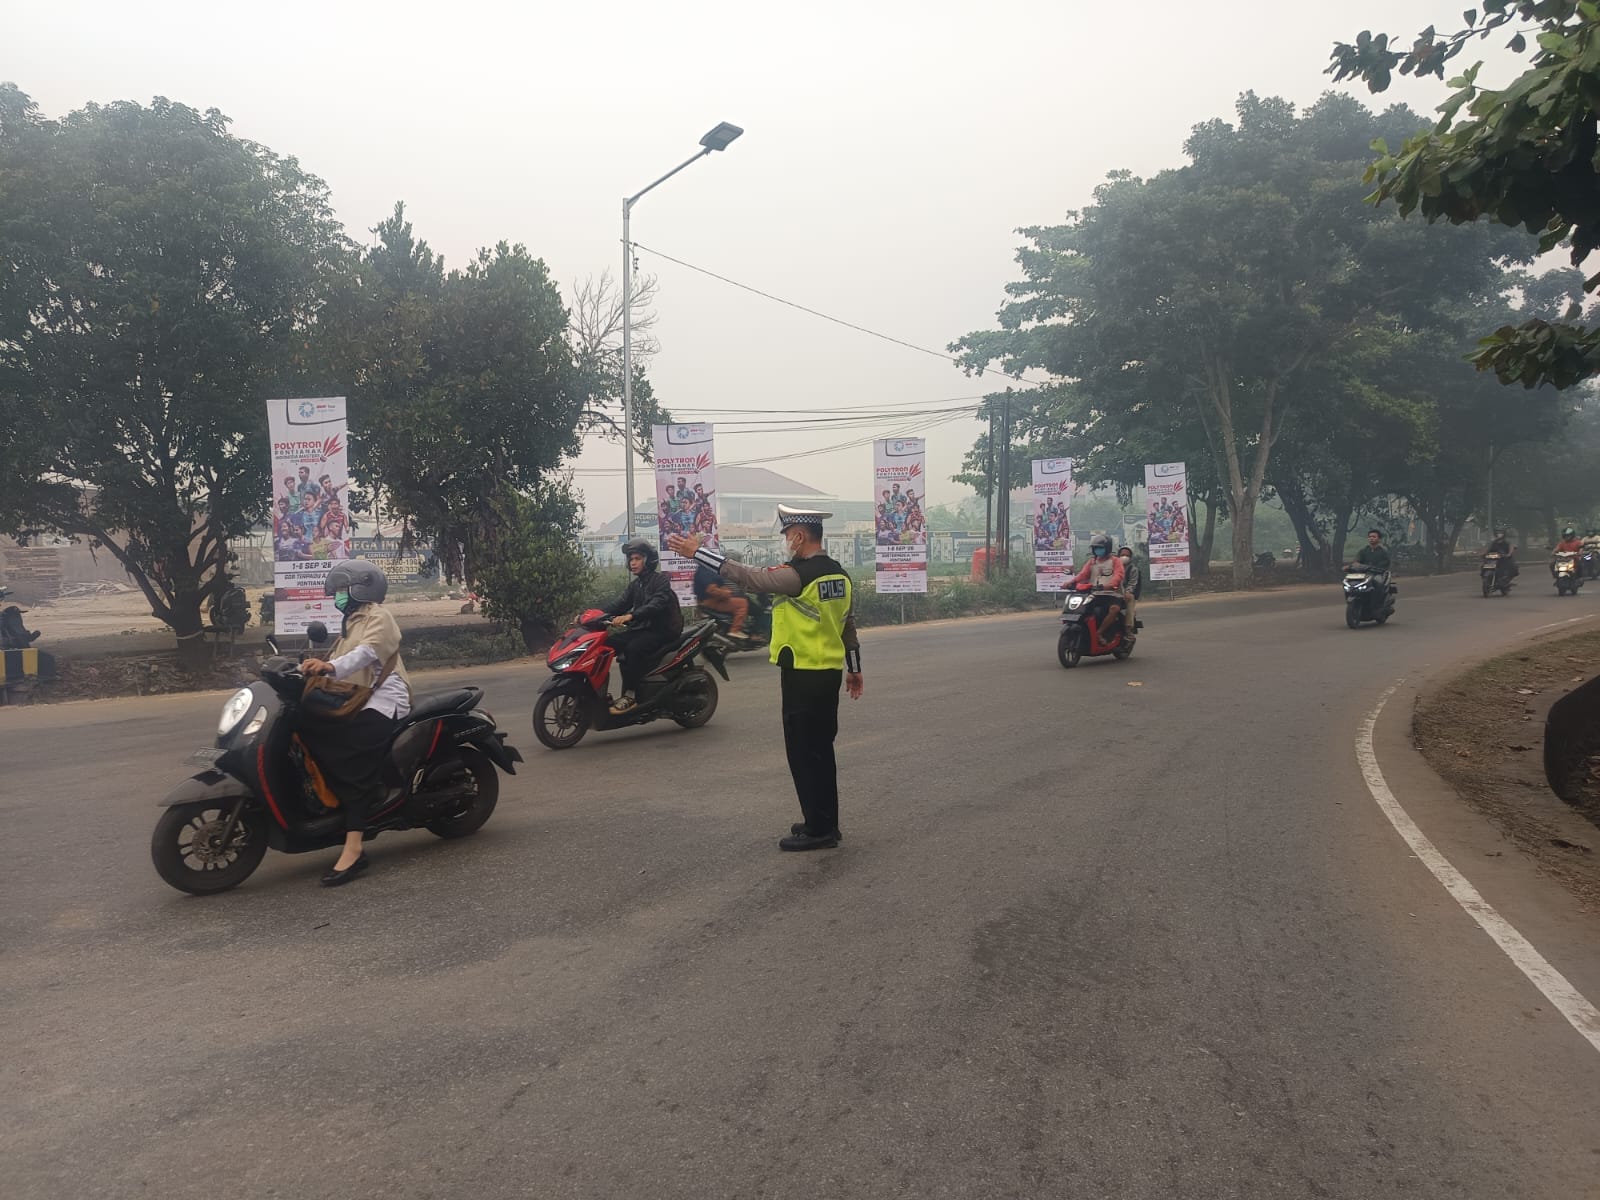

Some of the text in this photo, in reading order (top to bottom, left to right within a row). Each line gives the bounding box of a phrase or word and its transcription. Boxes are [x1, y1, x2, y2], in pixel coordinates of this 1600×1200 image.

[274, 441, 322, 450] POLYTRON
[274, 448, 322, 456] PONTIANAK
[656, 457, 696, 465] POLYTRON
